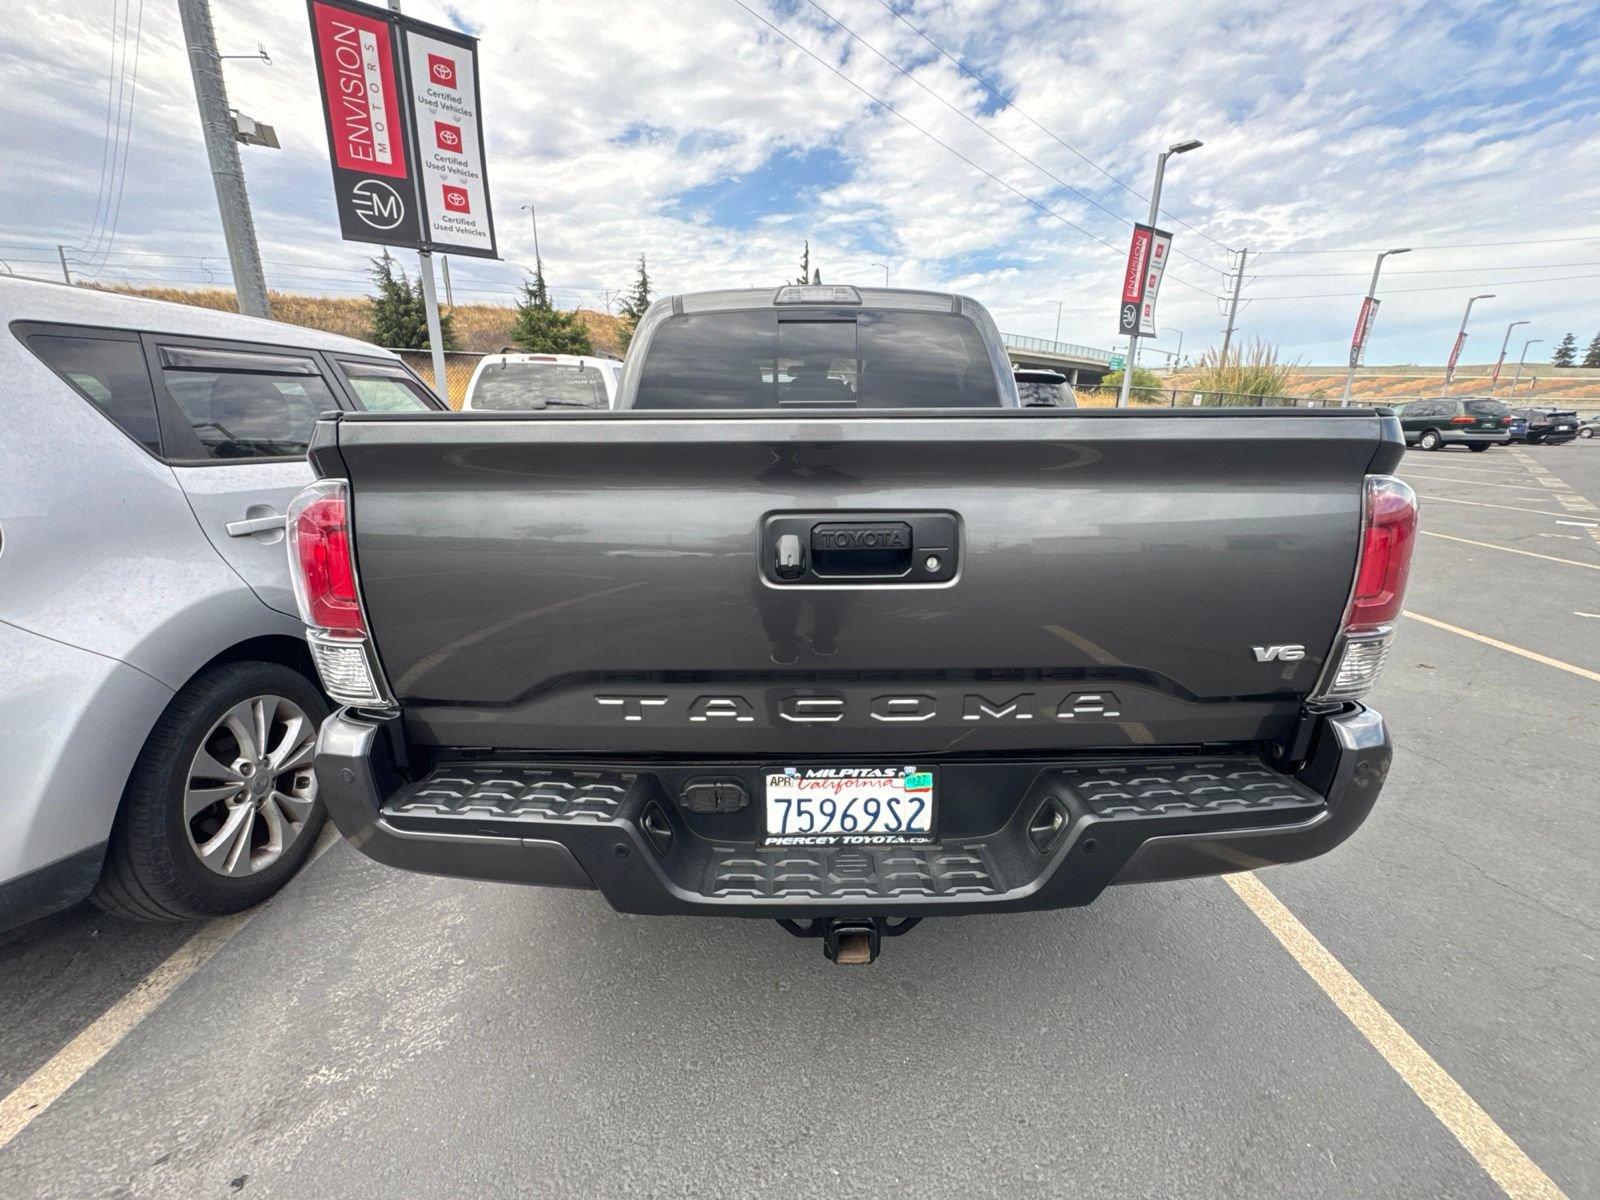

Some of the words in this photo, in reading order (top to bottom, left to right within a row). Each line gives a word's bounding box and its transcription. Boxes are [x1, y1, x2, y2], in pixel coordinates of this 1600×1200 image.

[331, 20, 374, 162] ENVISION
[364, 43, 388, 154] MOTORS
[426, 88, 462, 104] Certified
[417, 95, 439, 109] Used
[440, 101, 473, 118] Vehicles
[433, 153, 469, 168] Certified
[425, 161, 446, 173] Used
[447, 166, 479, 180] Vehicles
[433, 222, 454, 233] Used
[454, 225, 487, 238] Vehicles
[441, 215, 476, 228] Certified
[1126, 236, 1143, 298] ENVISION
[821, 530, 905, 549] TOYOTA
[1253, 645, 1305, 662] V6
[594, 690, 1122, 722] TACOMA
[770, 776, 792, 787] APR
[805, 768, 897, 778] MILPITAS
[797, 777, 905, 795] California
[774, 797, 926, 834] 75969S2
[765, 836, 839, 846] PIERCEY
